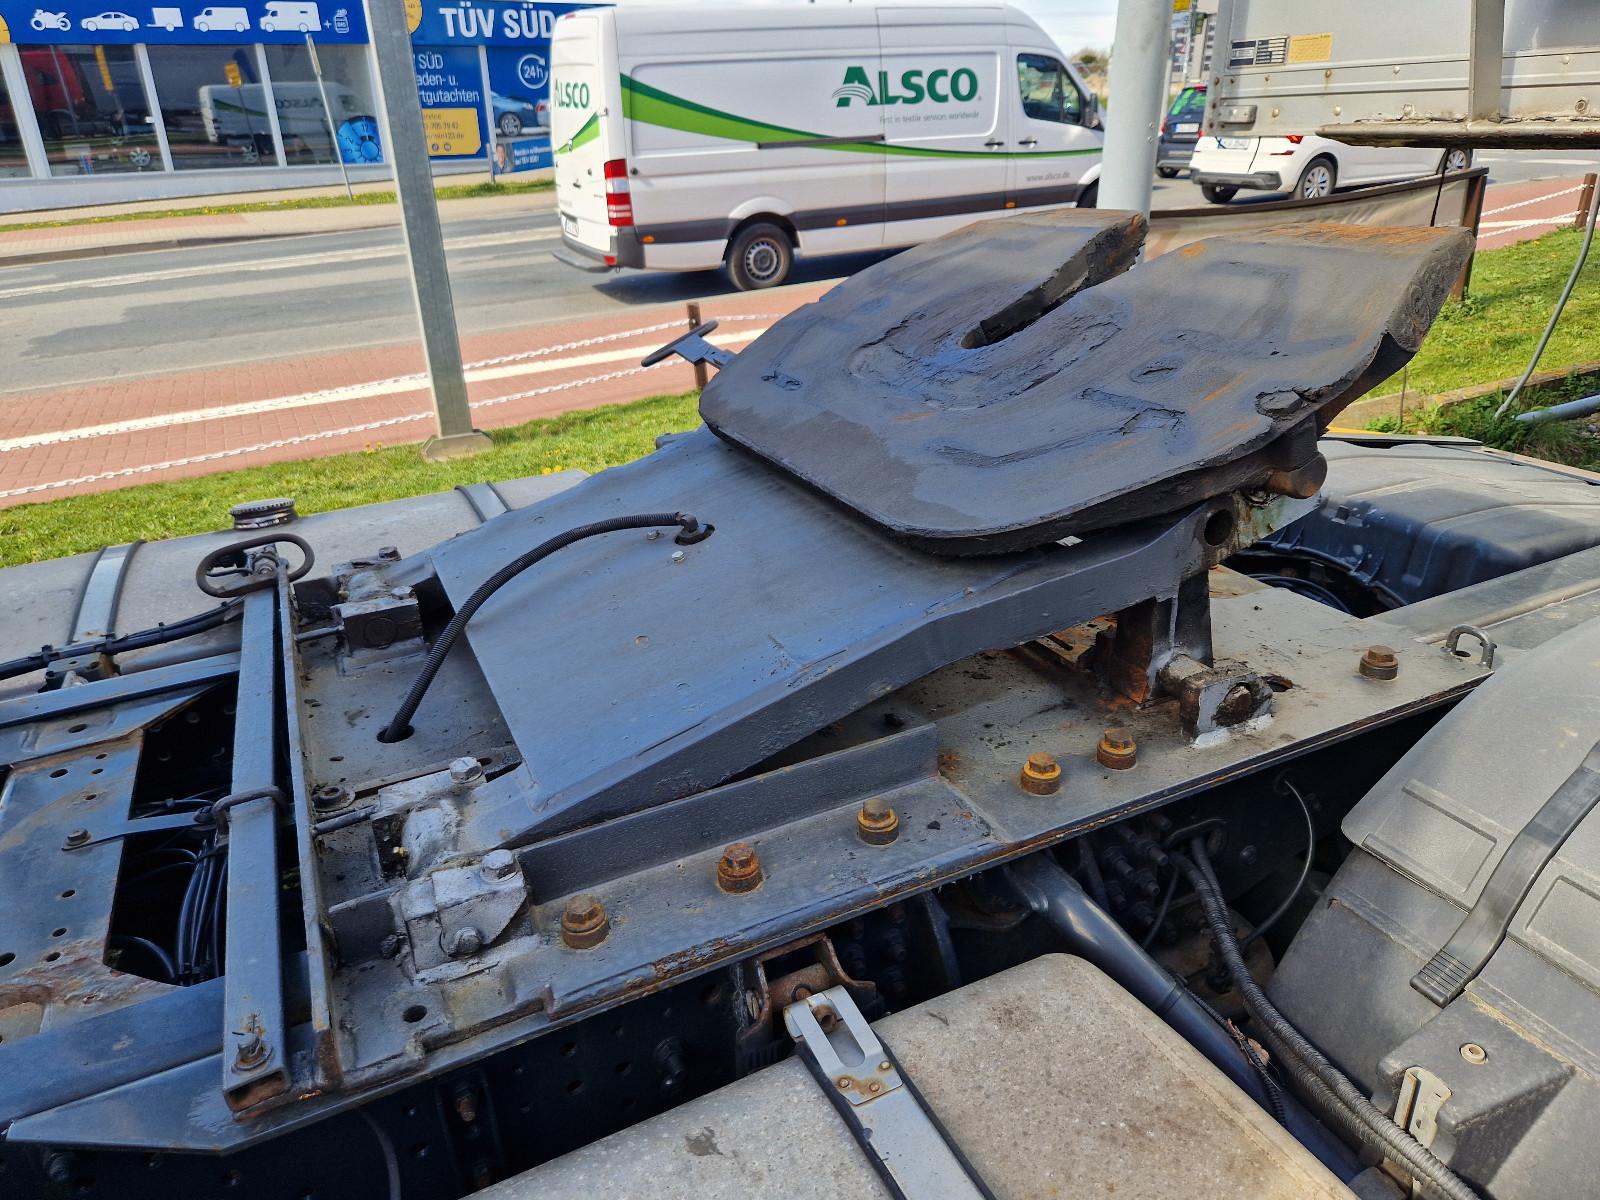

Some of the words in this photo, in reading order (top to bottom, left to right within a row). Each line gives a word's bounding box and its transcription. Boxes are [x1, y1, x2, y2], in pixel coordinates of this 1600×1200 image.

[439, 1, 495, 38] TÜV
[503, 4, 556, 39] SÜD
[419, 51, 443, 70] SÜD
[416, 71, 446, 87] aden-
[448, 75, 459, 87] u.
[554, 78, 590, 109] ALSCO
[832, 66, 978, 108] ALSCO
